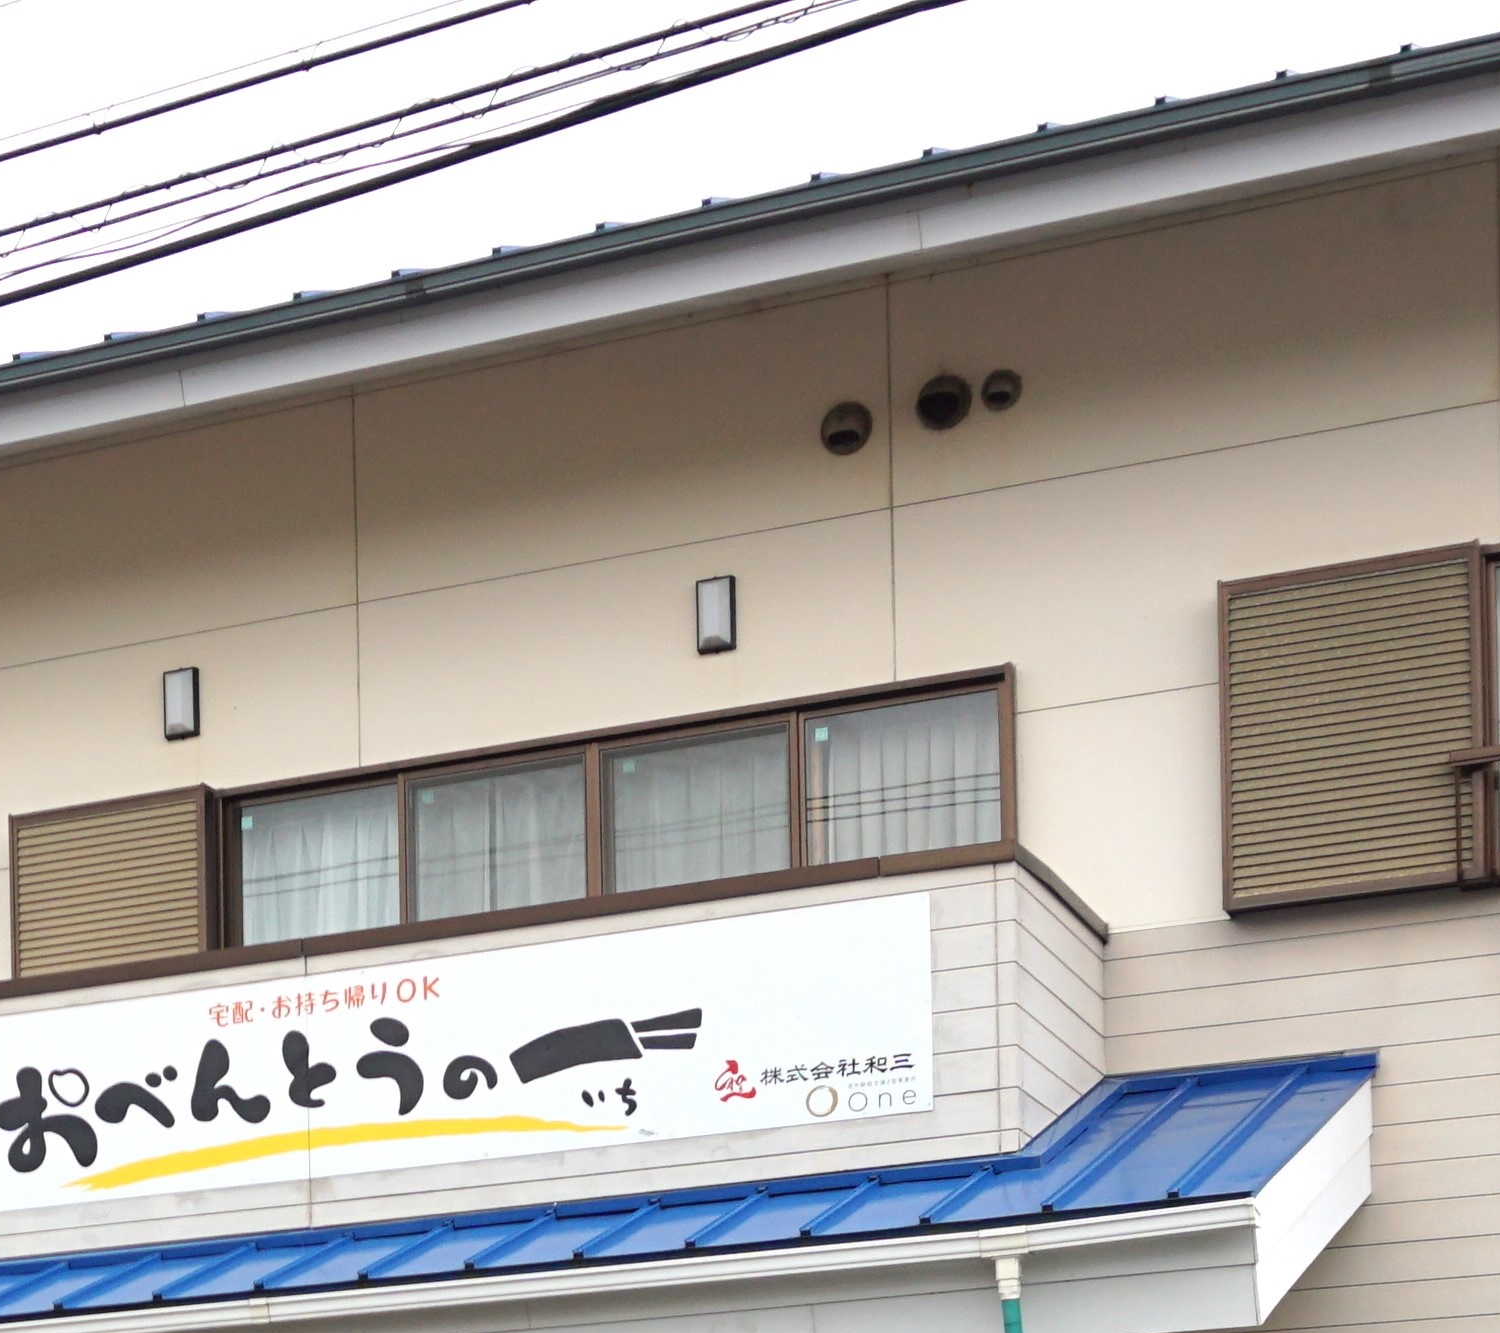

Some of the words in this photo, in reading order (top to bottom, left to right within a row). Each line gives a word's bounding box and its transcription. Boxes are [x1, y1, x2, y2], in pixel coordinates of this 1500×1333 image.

[207, 975, 441, 1027] 宅配・お持ち帰りOK
[581, 1077, 637, 1117] いち
